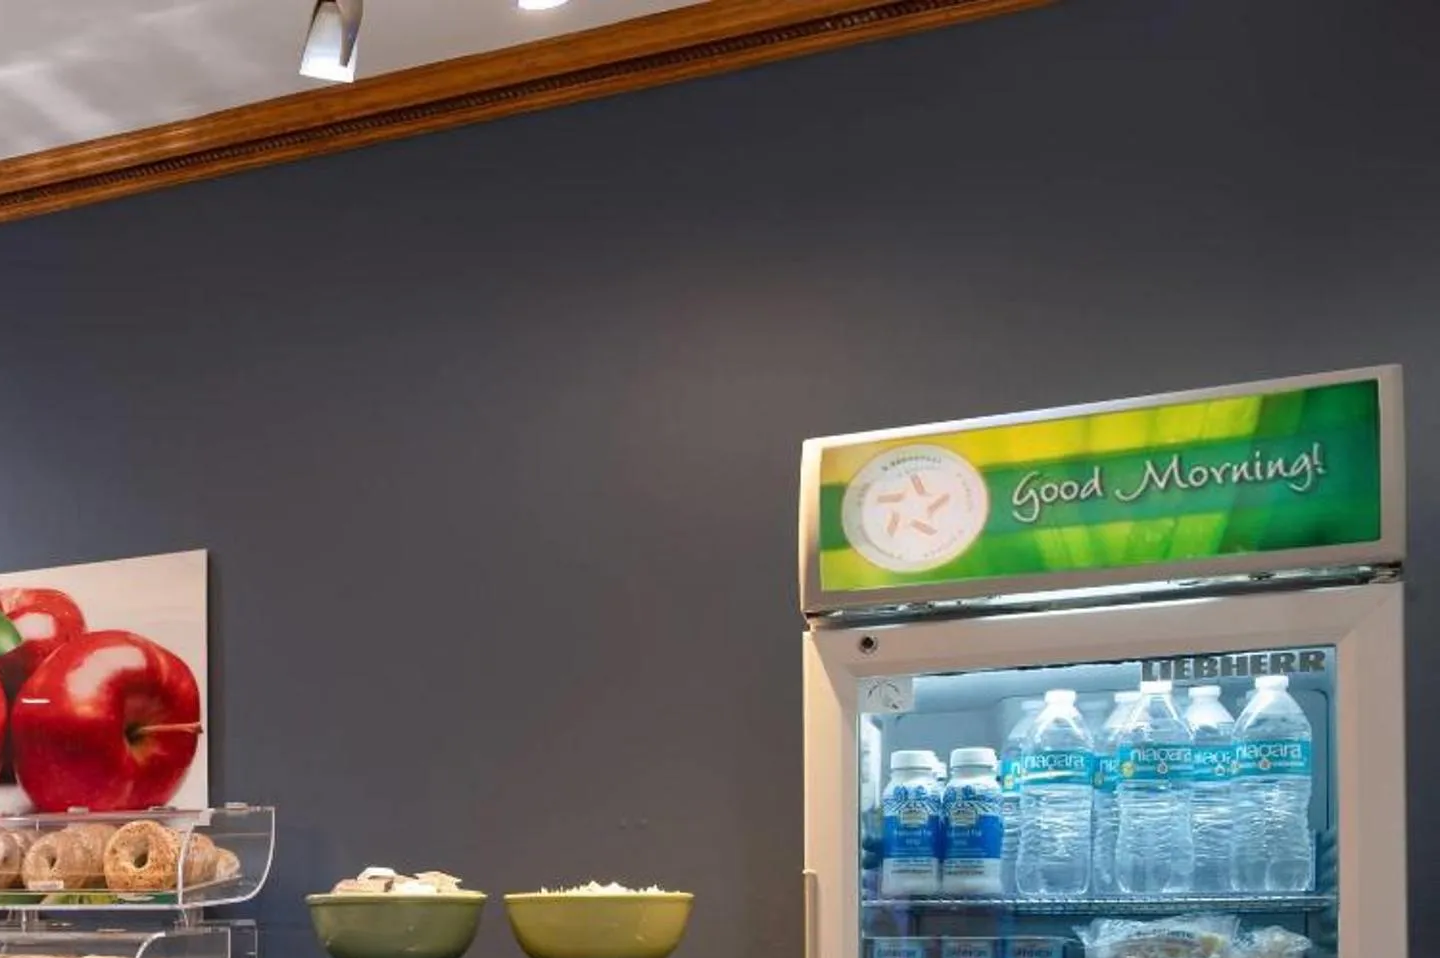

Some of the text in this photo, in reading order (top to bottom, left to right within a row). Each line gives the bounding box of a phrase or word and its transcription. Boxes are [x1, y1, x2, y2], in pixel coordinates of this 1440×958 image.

[1011, 465, 1102, 523] Good
[1115, 443, 1325, 503] Morning!
[1141, 651, 1326, 682] LIEBHERR
